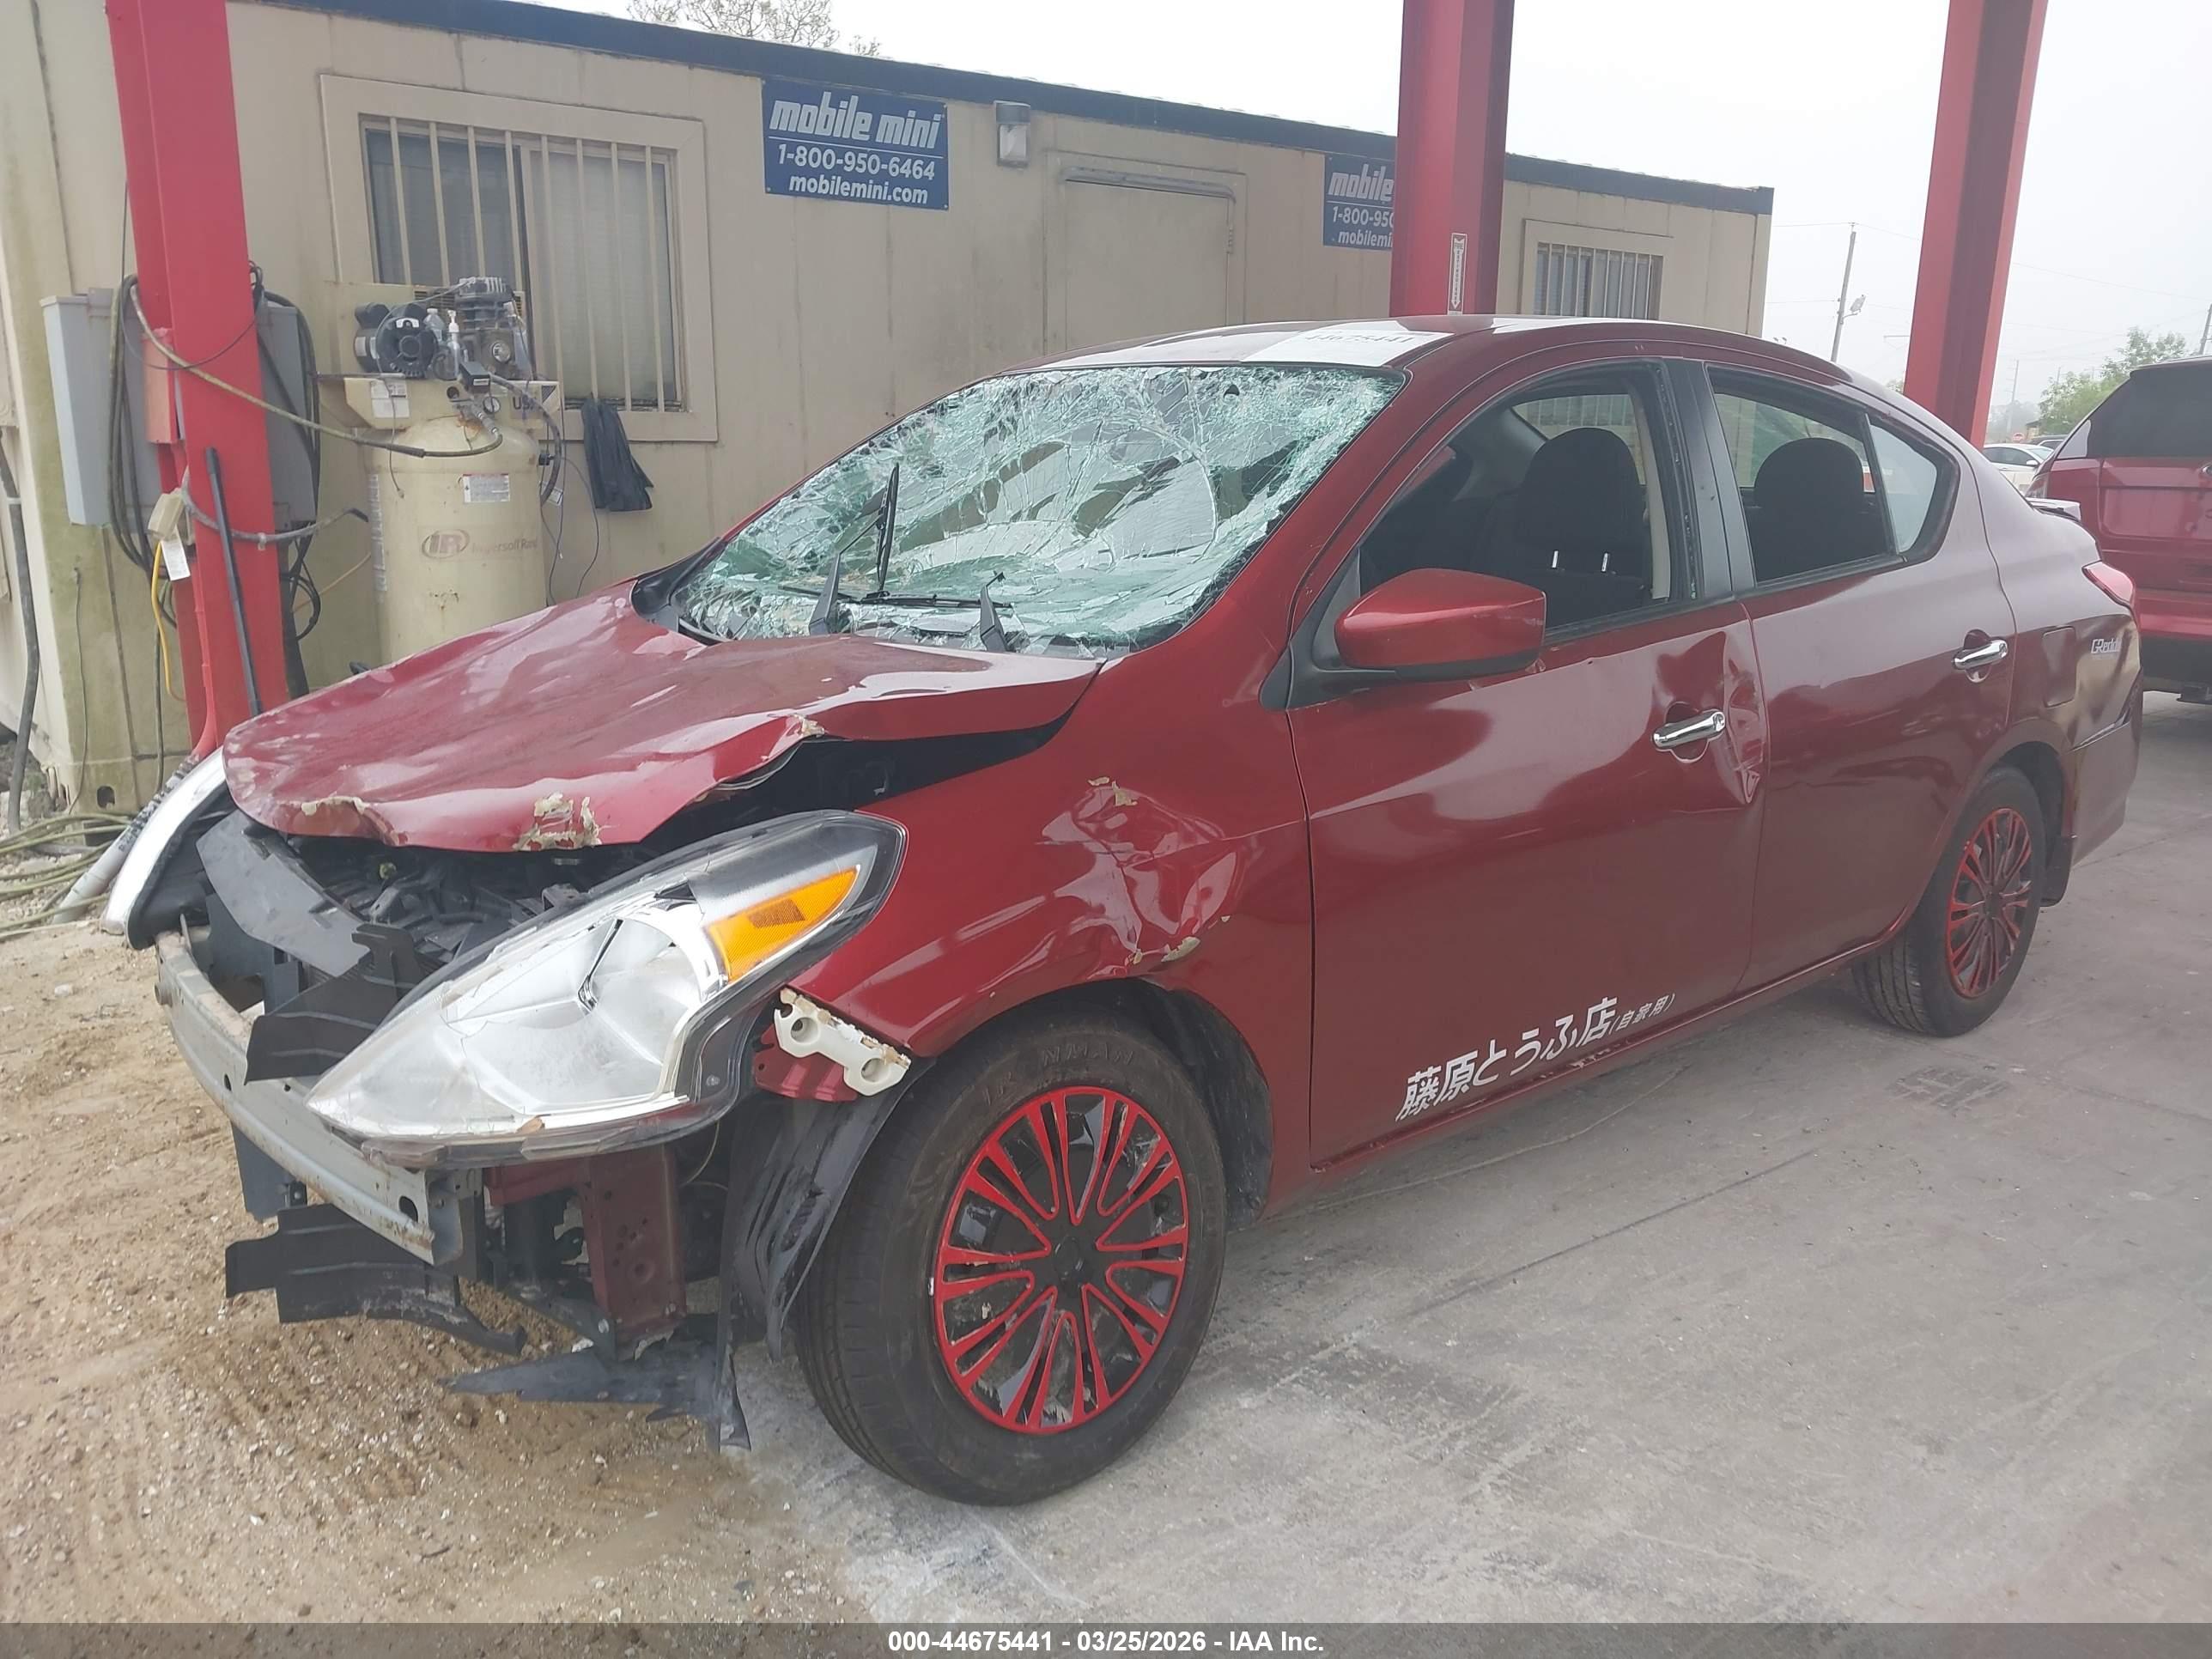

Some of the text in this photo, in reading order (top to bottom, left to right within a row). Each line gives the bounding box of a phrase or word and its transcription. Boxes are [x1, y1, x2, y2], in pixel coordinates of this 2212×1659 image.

[769, 91, 942, 149] mobile mini
[778, 143, 935, 180] 1-800-950-6464
[788, 174, 928, 204] mobilemini.com
[1328, 163, 1395, 202] mobile
[1338, 229, 1393, 248] mobilemi
